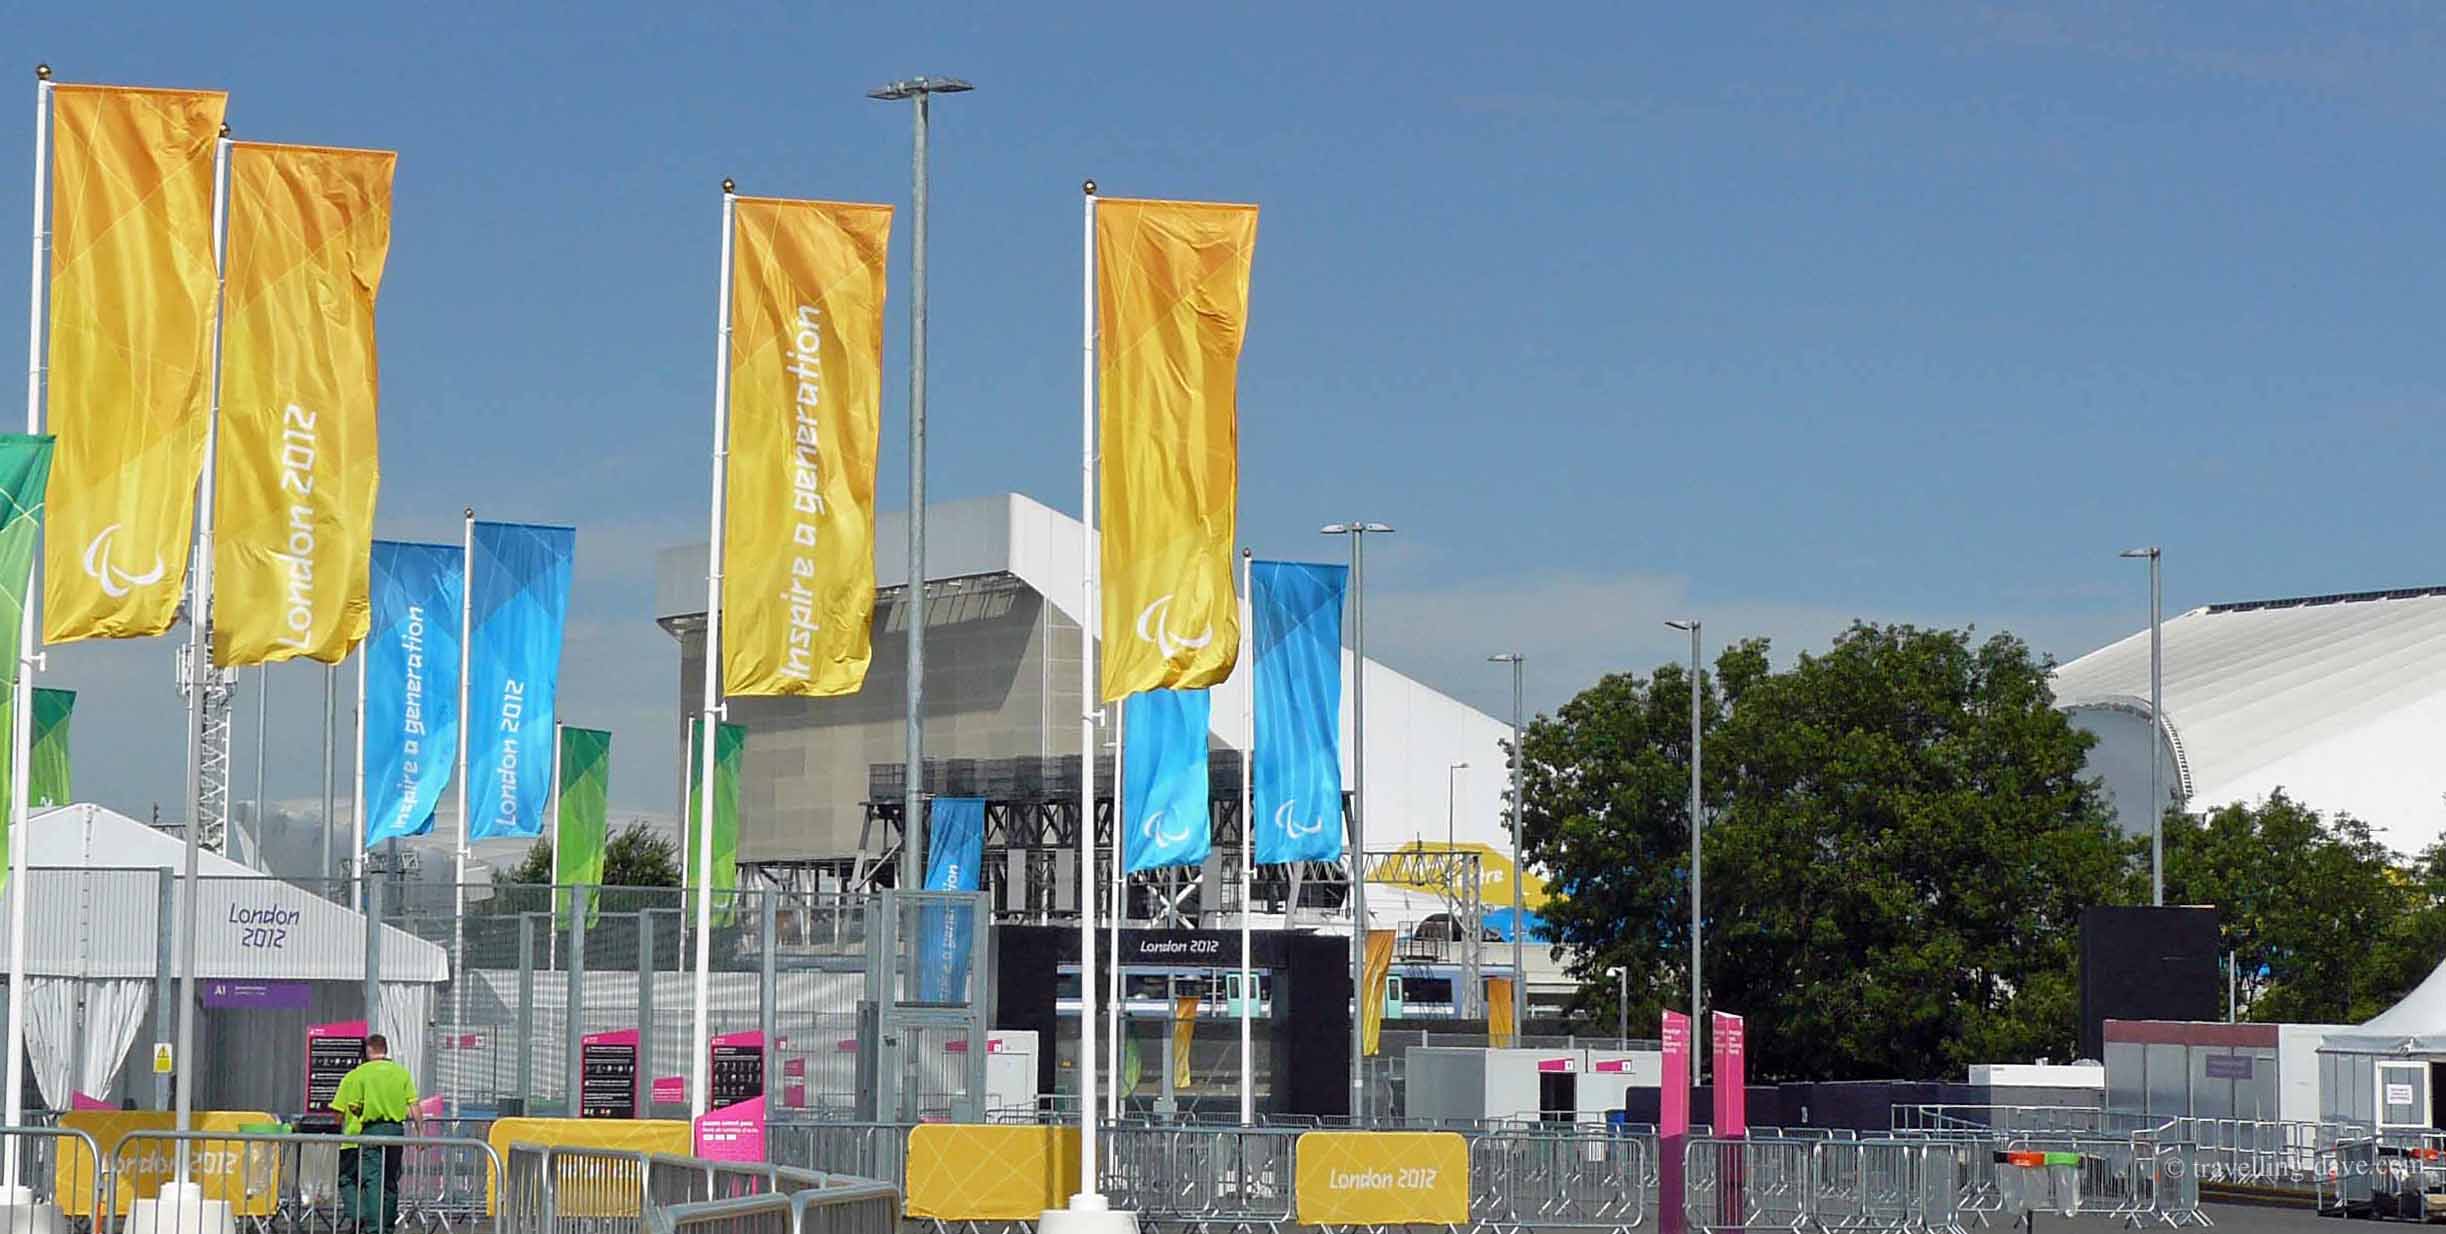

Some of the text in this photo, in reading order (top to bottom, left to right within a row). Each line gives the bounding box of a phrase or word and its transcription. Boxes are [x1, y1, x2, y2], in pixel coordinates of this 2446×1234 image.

[781, 304, 825, 680] Inspire a generation
[276, 402, 318, 650] London 2012
[391, 606, 426, 829] Inspire a generation
[496, 679, 525, 826] London 2012
[229, 902, 300, 925] London
[241, 928, 286, 948] 2012
[1140, 940, 1219, 953] London 2012
[190, 1150, 238, 1175] 2012
[1328, 1167, 1438, 1190] London 2012
